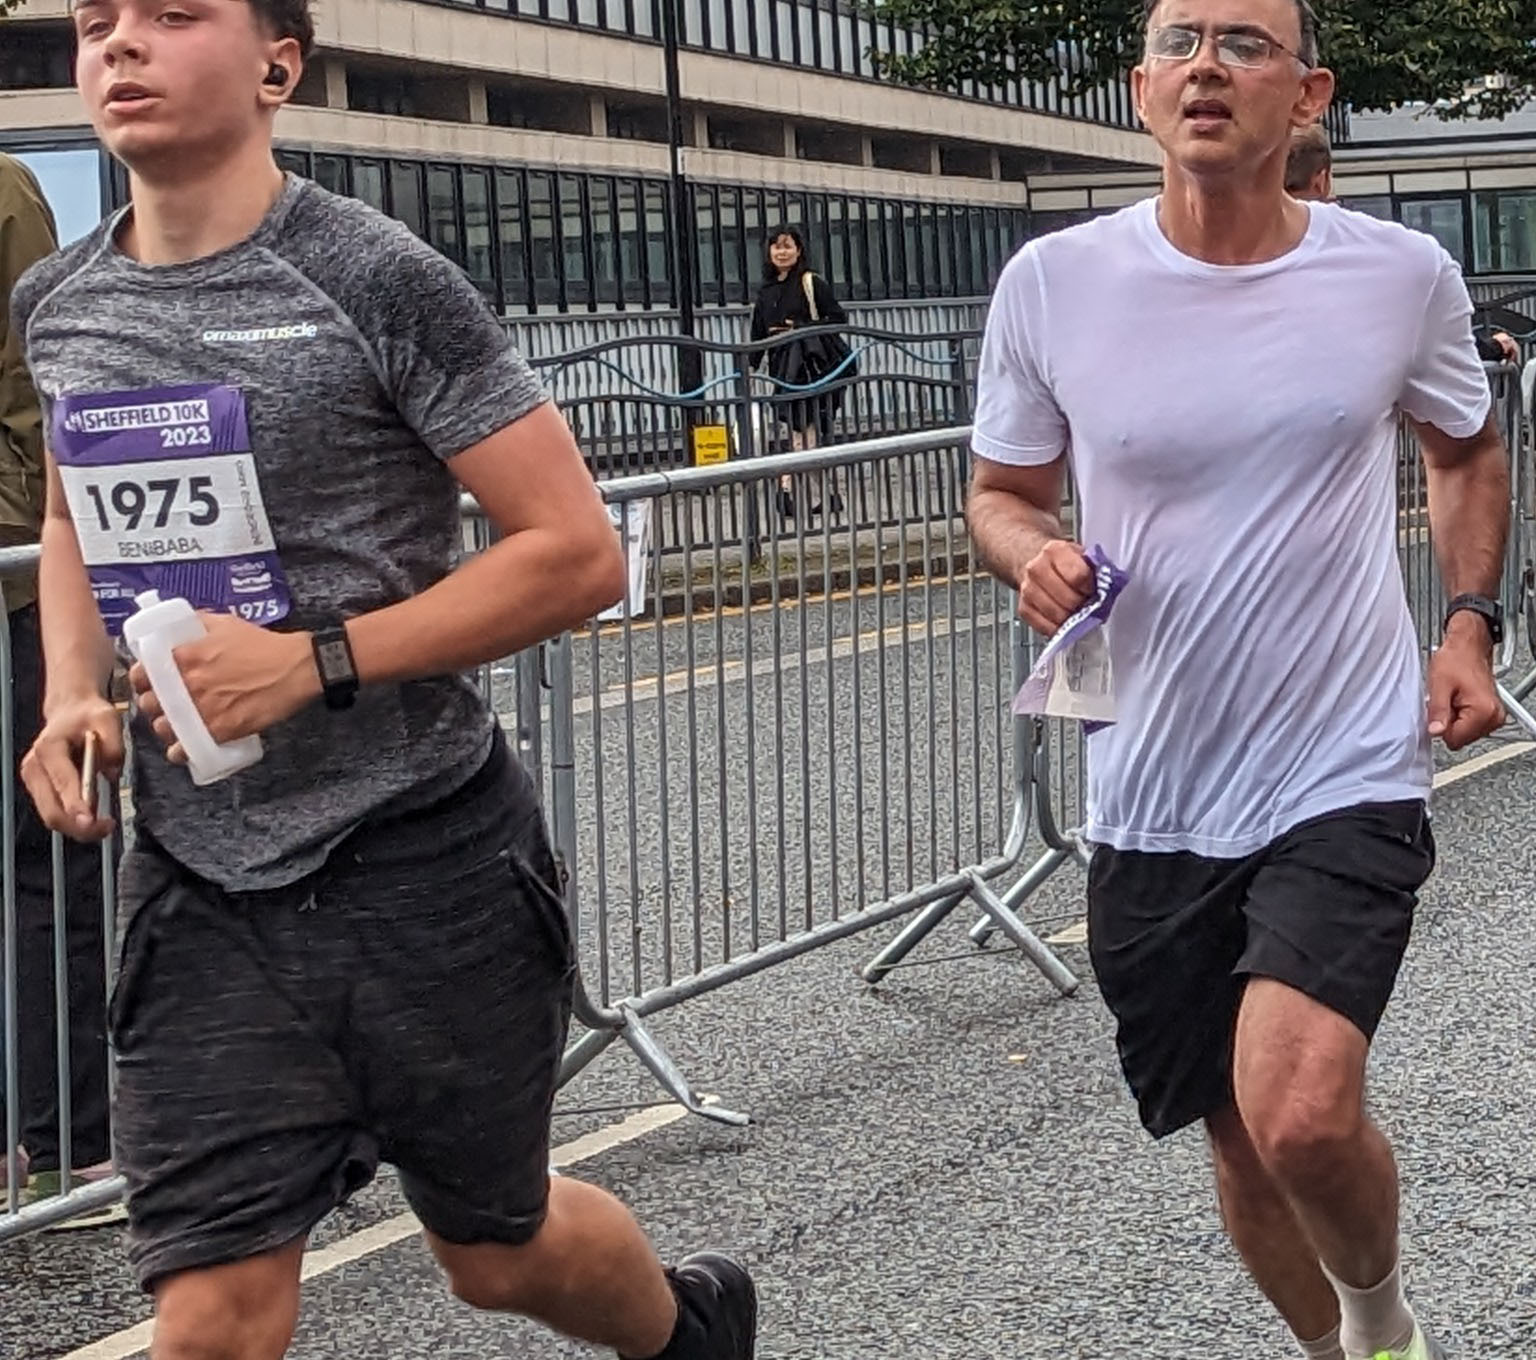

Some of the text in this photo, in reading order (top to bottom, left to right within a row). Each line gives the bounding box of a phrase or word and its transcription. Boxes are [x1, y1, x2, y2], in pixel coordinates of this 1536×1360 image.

[87, 406, 171, 430] SHEFFIELD
[174, 403, 207, 421] 10K
[160, 425, 212, 448] 2023
[86, 476, 220, 531] 1975
